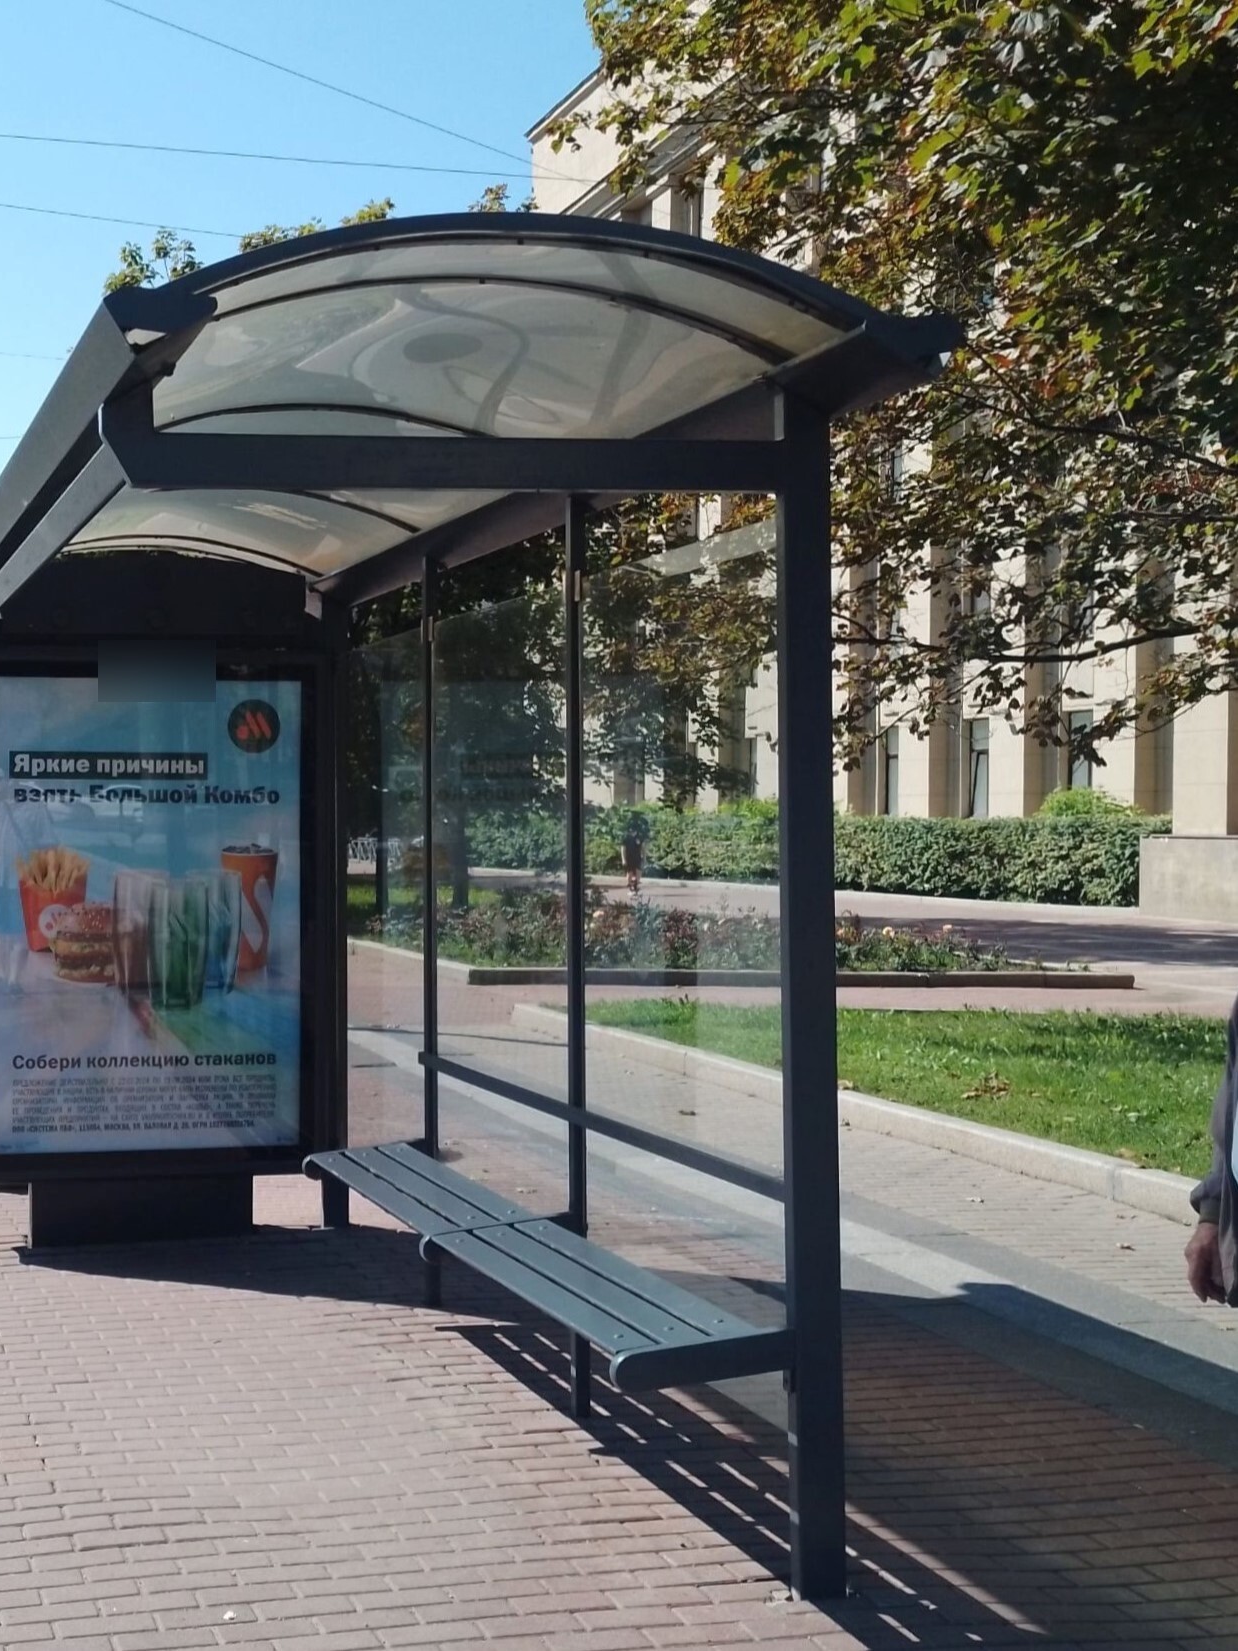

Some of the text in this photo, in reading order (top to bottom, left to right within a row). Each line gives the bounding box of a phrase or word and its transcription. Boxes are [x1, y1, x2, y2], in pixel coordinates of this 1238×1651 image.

[14, 754, 204, 777] Яркие причины
[89, 784, 198, 804] Большой
[205, 785, 280, 805] Комбо
[12, 1053, 276, 1071] Собери коллекцию стаканов
